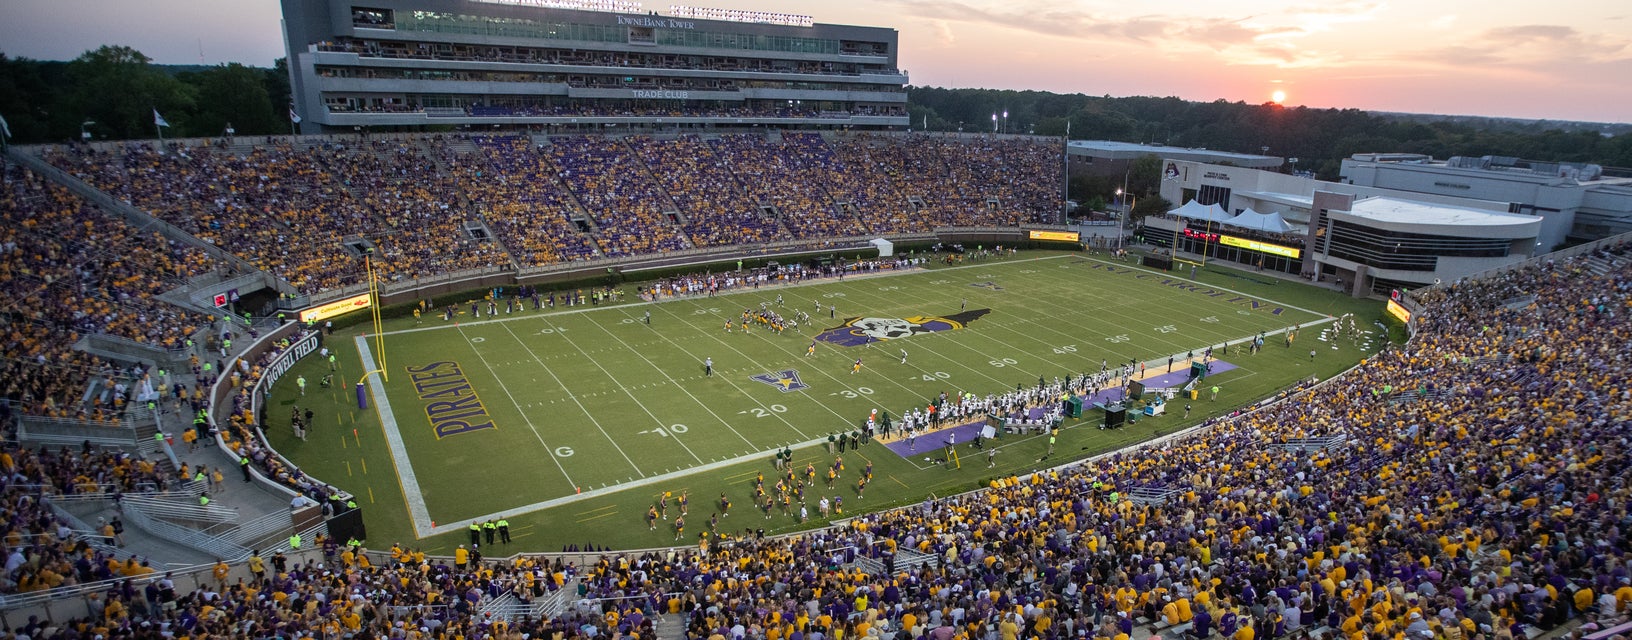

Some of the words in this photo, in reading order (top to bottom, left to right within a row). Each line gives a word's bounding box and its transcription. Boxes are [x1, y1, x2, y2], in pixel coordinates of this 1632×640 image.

[632, 90, 662, 98] TRADE
[665, 90, 688, 99] CLUB
[294, 336, 318, 361] FIELD
[988, 357, 1018, 368] 50
[921, 371, 951, 382] 40
[840, 386, 875, 399] 30
[405, 360, 498, 441] PIRATES
[750, 404, 788, 419] 20
[651, 423, 689, 438] 10
[555, 446, 575, 458] G
